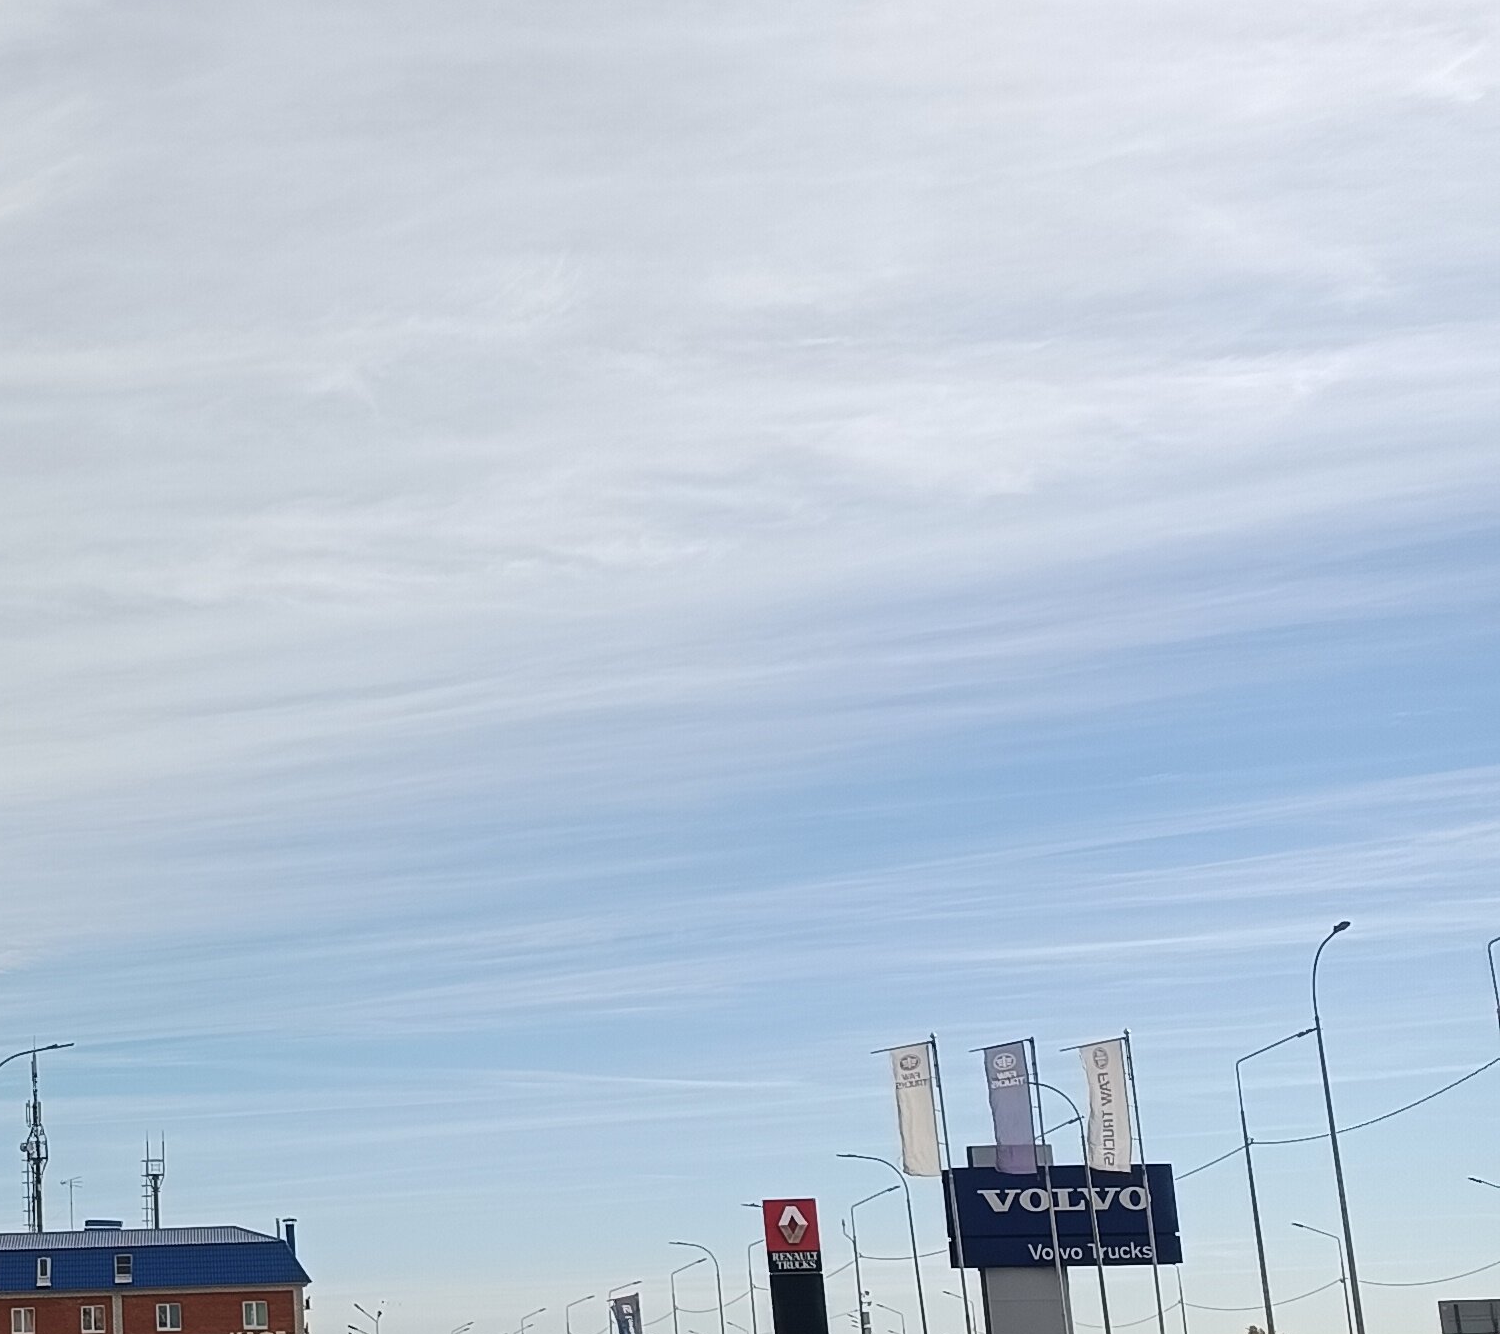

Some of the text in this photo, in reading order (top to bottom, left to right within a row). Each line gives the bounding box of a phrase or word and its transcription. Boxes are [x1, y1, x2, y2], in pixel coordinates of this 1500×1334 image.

[977, 1186, 1151, 1212] VOLVO
[772, 1251, 818, 1261] RENAULT
[1028, 1241, 1153, 1260] Vovo Trucks
[776, 1260, 817, 1269] TRUCKS
